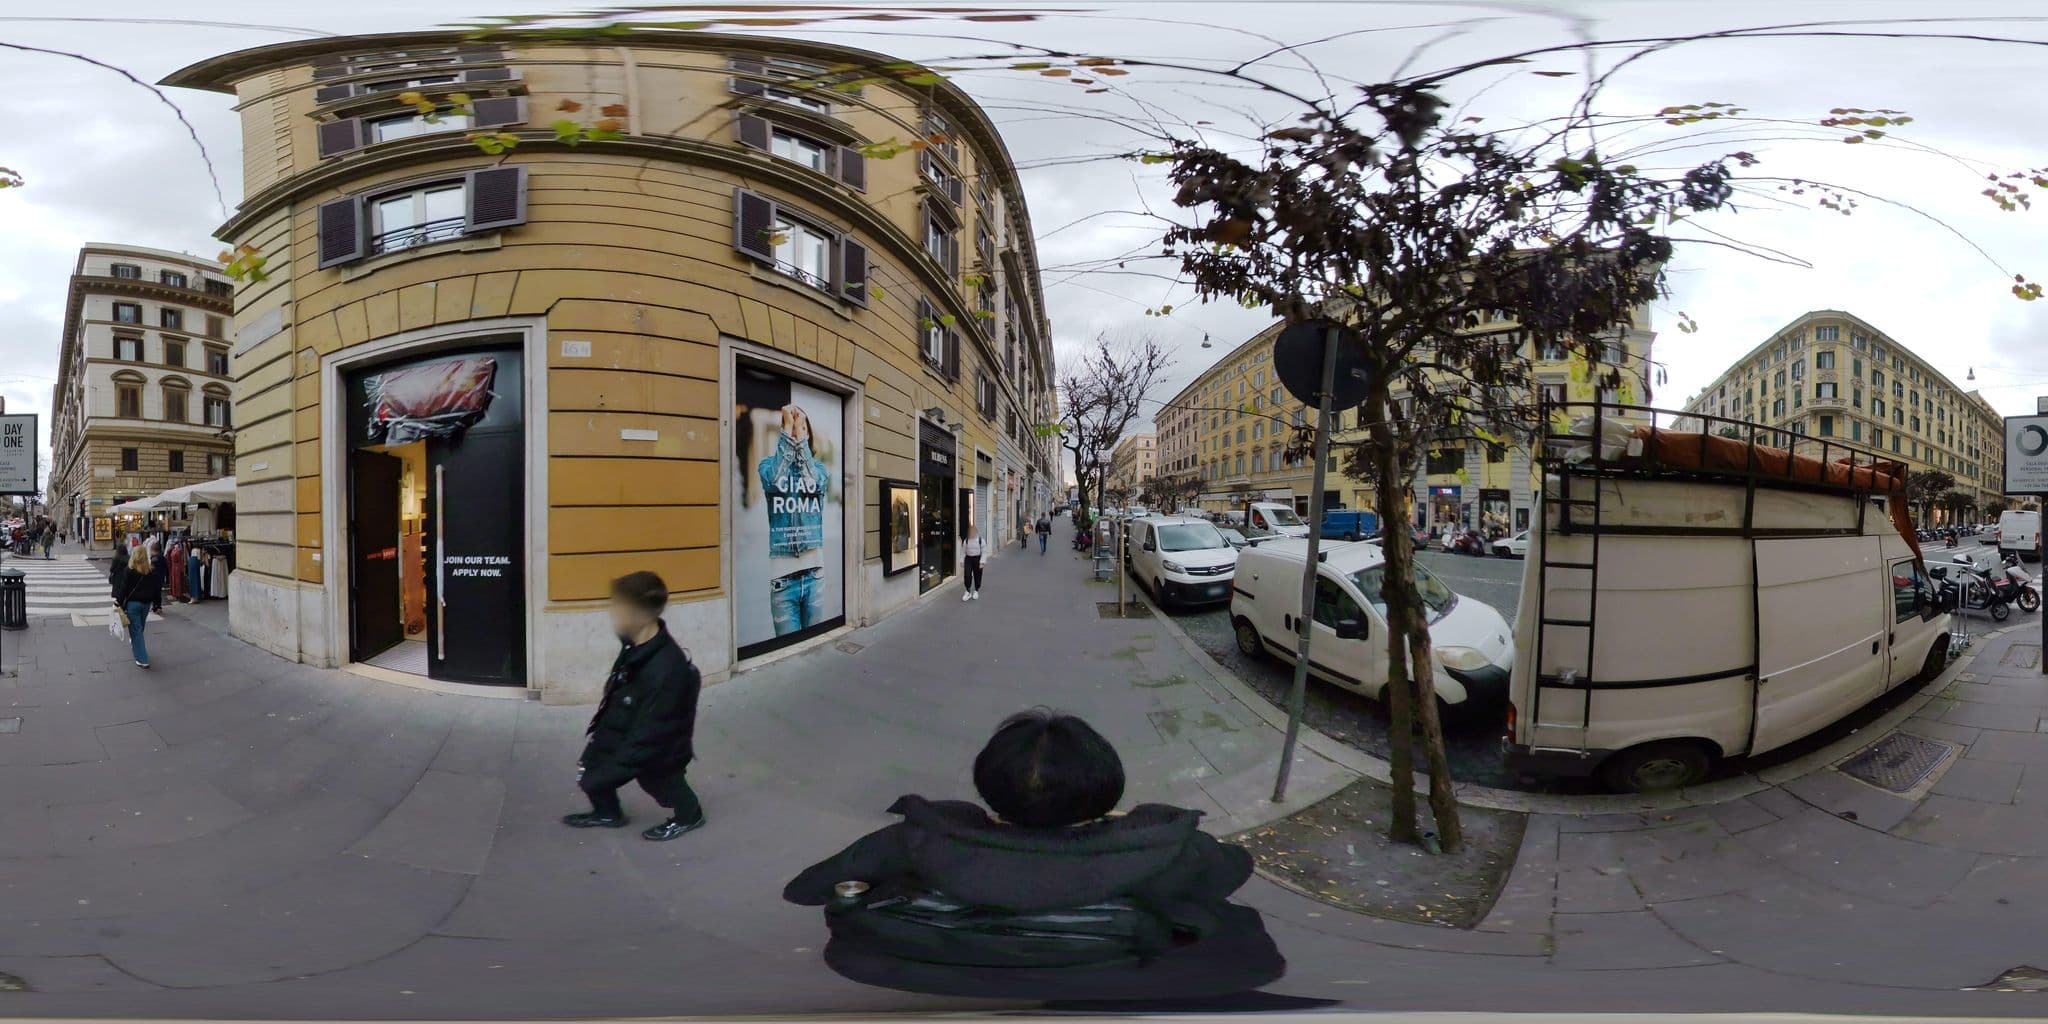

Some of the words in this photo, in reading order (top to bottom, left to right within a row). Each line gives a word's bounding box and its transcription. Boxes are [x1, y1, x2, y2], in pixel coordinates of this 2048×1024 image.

[4, 423, 23, 435] DAY
[3, 436, 24, 448] ONE
[777, 475, 817, 494] CIAO
[773, 496, 821, 514] ROMA
[444, 556, 463, 564] JOIN
[464, 556, 483, 564] OUR
[484, 556, 511, 564] TEAM.
[452, 568, 479, 577] APPLY
[480, 568, 502, 577] NOW.
